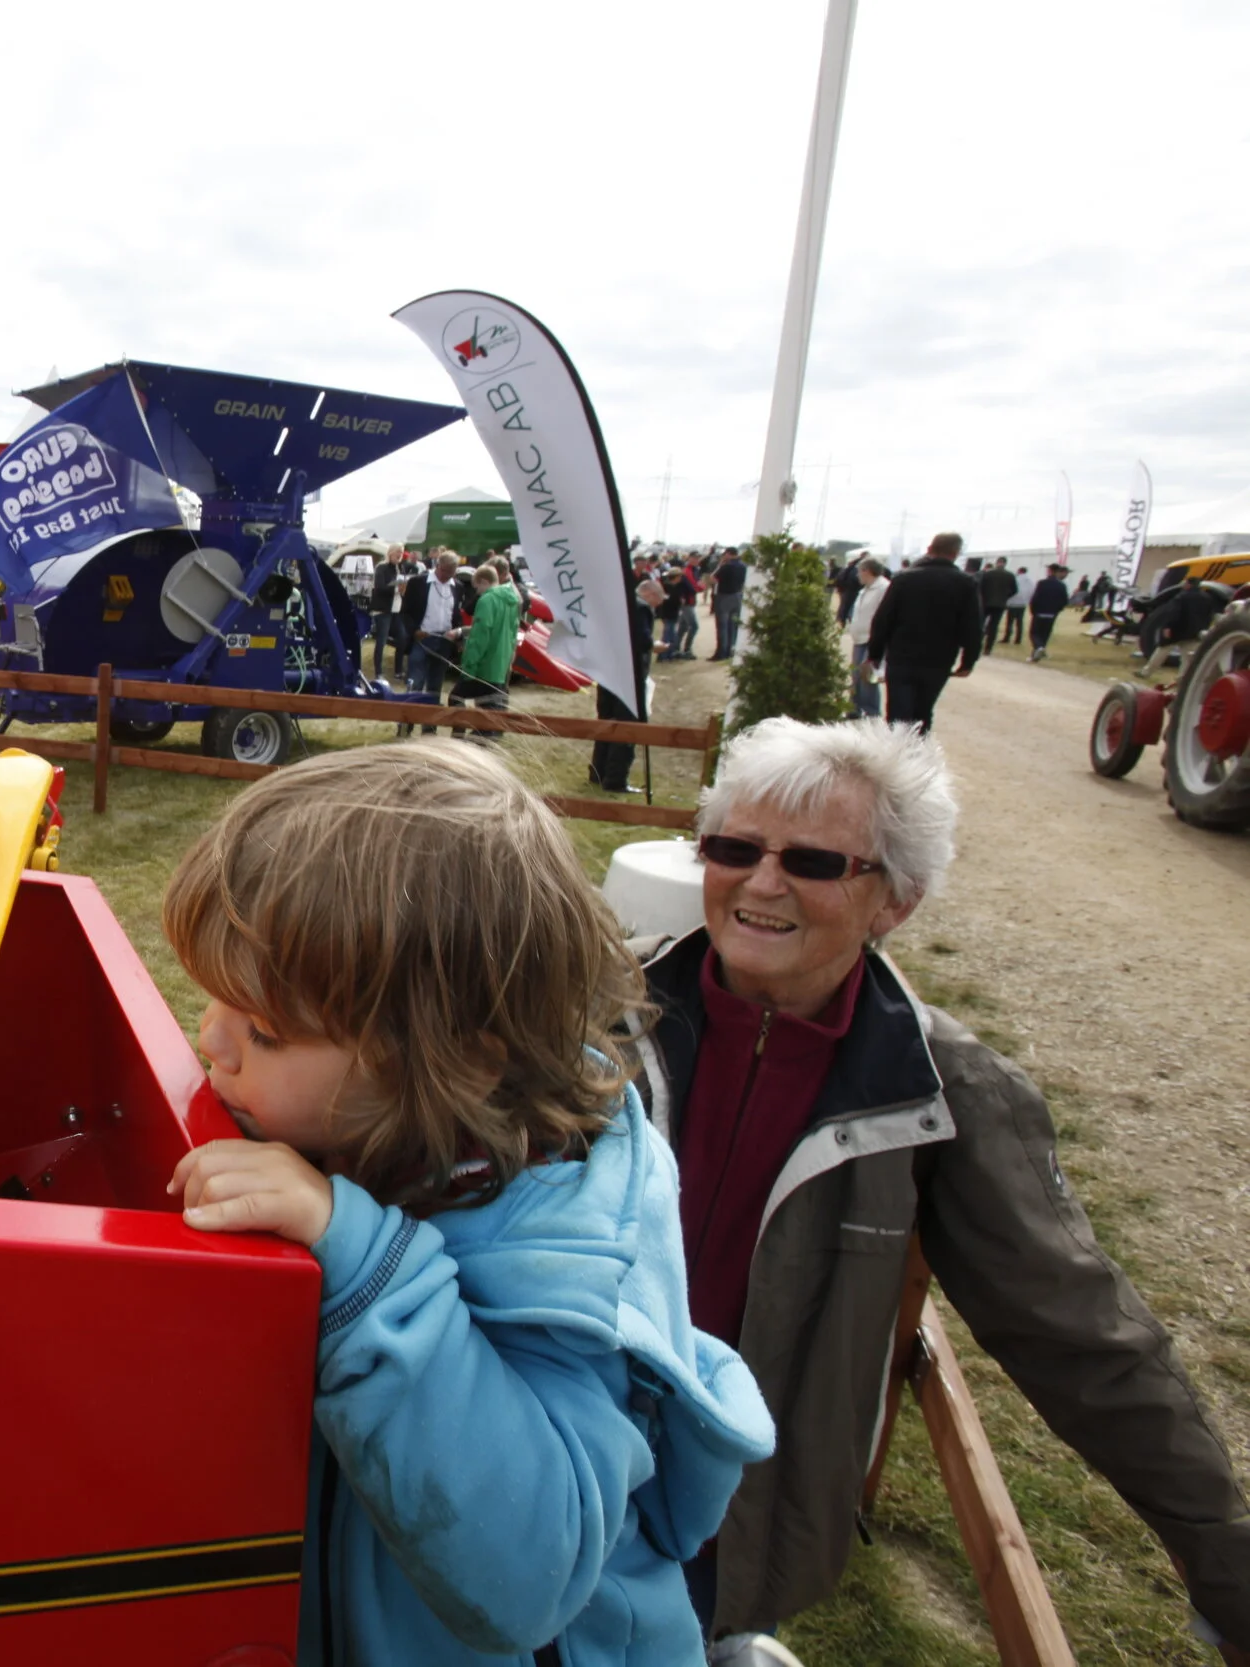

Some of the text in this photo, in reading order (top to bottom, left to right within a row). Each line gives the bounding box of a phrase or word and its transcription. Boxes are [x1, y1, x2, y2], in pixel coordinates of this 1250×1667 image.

[213, 399, 394, 436] GRAIN SAVER
[486, 382, 532, 431] AB
[317, 443, 350, 462] W9
[515, 444, 563, 528] MAC
[547, 538, 588, 639] FARM
